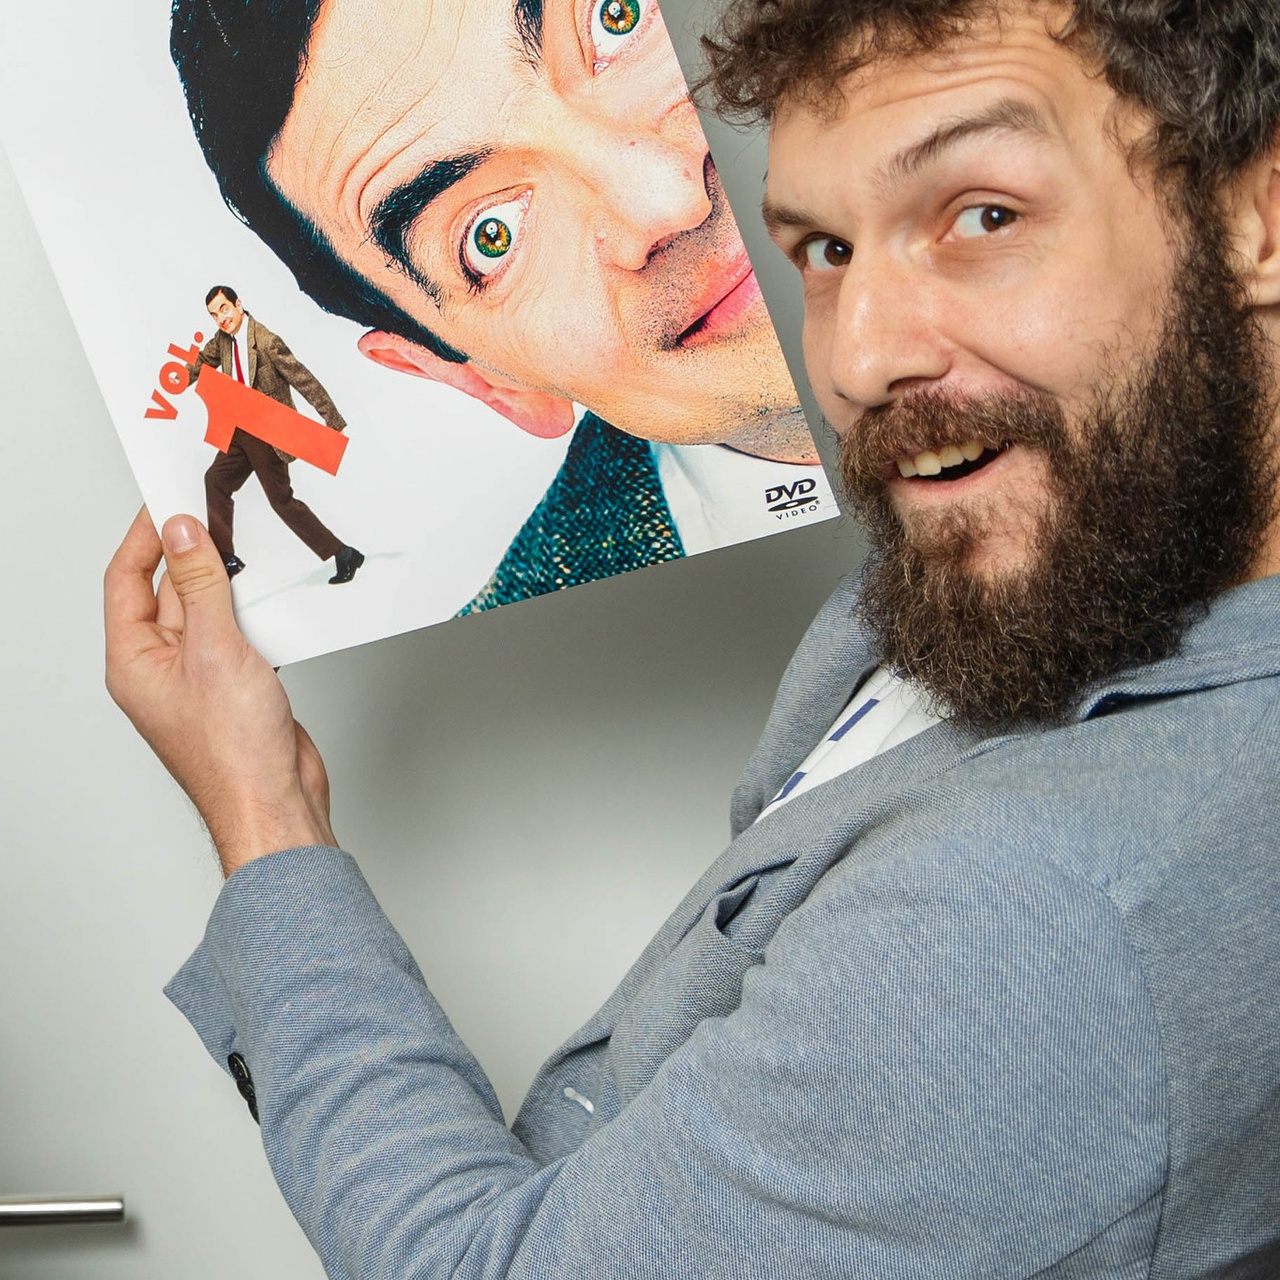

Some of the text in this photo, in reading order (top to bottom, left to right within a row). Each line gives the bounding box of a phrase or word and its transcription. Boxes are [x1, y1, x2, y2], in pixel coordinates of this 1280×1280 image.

[144, 331, 204, 421] VOL.
[765, 478, 817, 504] DVD
[776, 505, 817, 520] VIDEO
